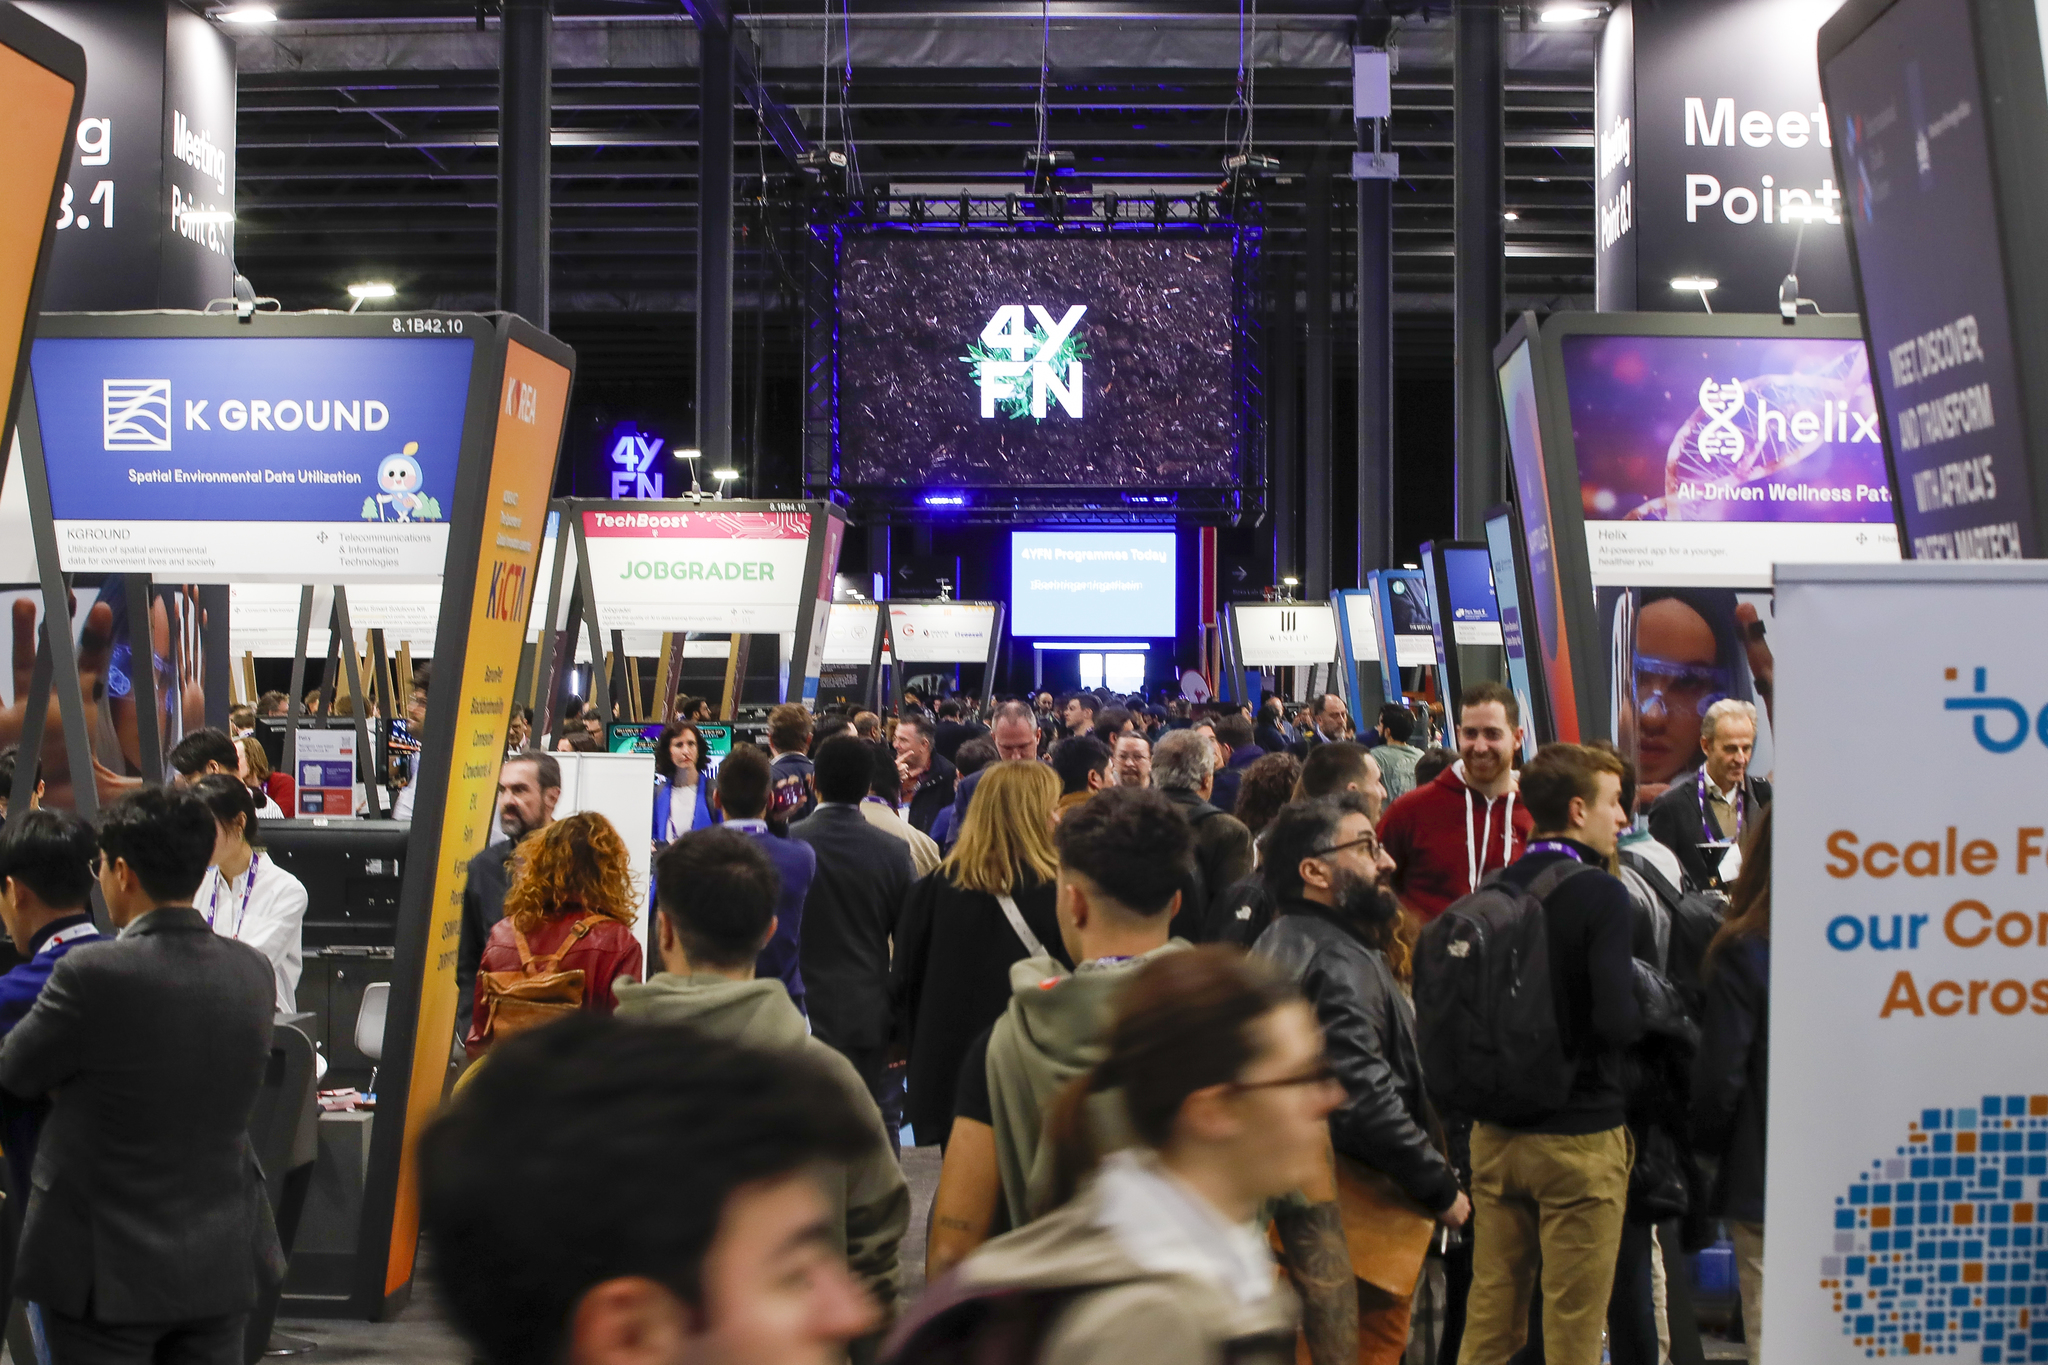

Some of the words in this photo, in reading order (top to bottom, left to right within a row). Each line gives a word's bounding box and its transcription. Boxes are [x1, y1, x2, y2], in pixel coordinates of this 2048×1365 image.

[172, 109, 226, 196] Meeting
[1600, 115, 1631, 181] Meeting
[1685, 173, 1842, 225] Point
[1601, 194, 1620, 252] Point
[392, 318, 464, 334] 8.1B42.10
[1919, 314, 1984, 382] DISCOVER,
[184, 399, 212, 431] K
[218, 399, 391, 432] GROUND
[1757, 400, 1881, 443] helix
[1898, 408, 1920, 452] AND
[1918, 383, 1995, 447] TRANSFORM
[128, 468, 173, 484] Spatial
[174, 468, 263, 484] Environmental
[265, 470, 296, 484] Data
[298, 470, 362, 485] Utilization
[1677, 483, 1764, 501] AI-Driven
[1768, 483, 1852, 502] Wellness
[1856, 484, 1893, 502] Pat
[594, 513, 689, 529] TechBoost
[67, 528, 130, 540] KGROUND
[338, 533, 432, 544] Telecommunications
[1598, 529, 1628, 541] Helix
[68, 545, 107, 554] Utilization
[110, 545, 118, 554] of
[120, 545, 148, 556] spatial
[149, 545, 208, 555] environmental
[339, 546, 346, 555] &
[348, 546, 399, 556] Information
[1021, 548, 1053, 561] 4YFN
[1055, 548, 1129, 563] Programmes
[1130, 548, 1167, 563] Today
[1598, 546, 1648, 556] AI-powered
[1650, 547, 1666, 557] app
[1667, 546, 1680, 556] for
[1690, 548, 1728, 558] younger,
[68, 557, 87, 566] data
[88, 557, 99, 566] for
[101, 558, 146, 567] convenient
[148, 558, 167, 567] lives
[169, 558, 186, 567] and
[187, 558, 216, 568] society
[339, 557, 399, 569] Technologies
[1598, 556, 1639, 567] healthier
[1640, 558, 1654, 568] you
[619, 561, 775, 581] JOBGRADER
[1825, 826, 1998, 879] Scale
[2016, 827, 2048, 875] F
[1826, 913, 1929, 952] our
